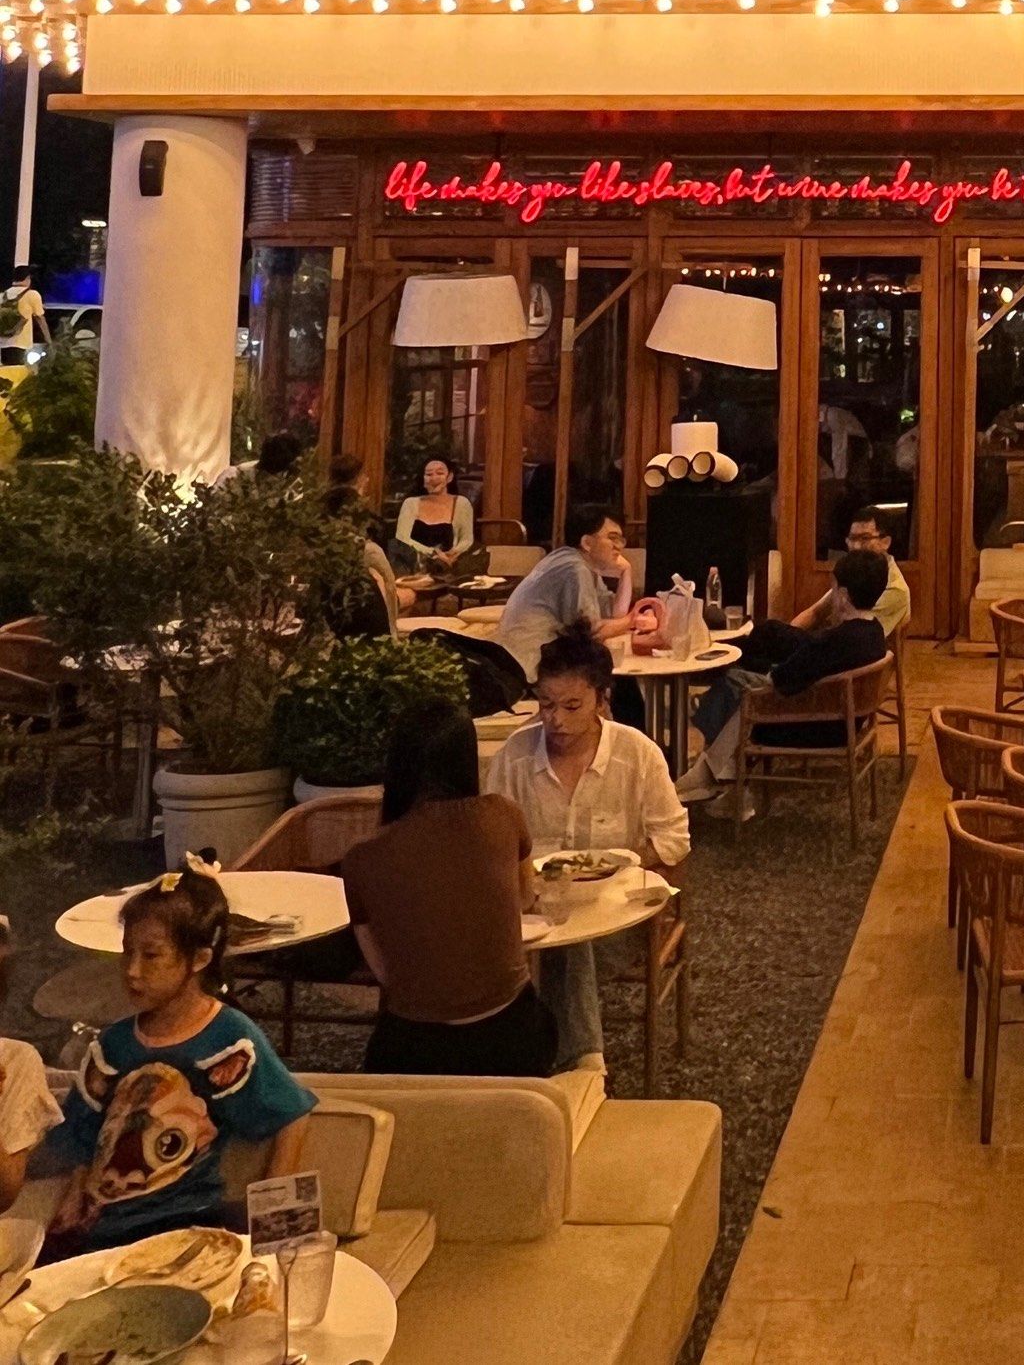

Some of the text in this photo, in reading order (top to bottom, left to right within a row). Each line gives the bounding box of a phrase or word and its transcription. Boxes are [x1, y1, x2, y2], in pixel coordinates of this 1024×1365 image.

[385, 161, 438, 210] life
[440, 161, 527, 205] makes
[581, 161, 637, 202] like
[778, 176, 848, 199] wine
[850, 160, 937, 205] makes
[933, 181, 989, 223] you
[991, 167, 1020, 200] be
